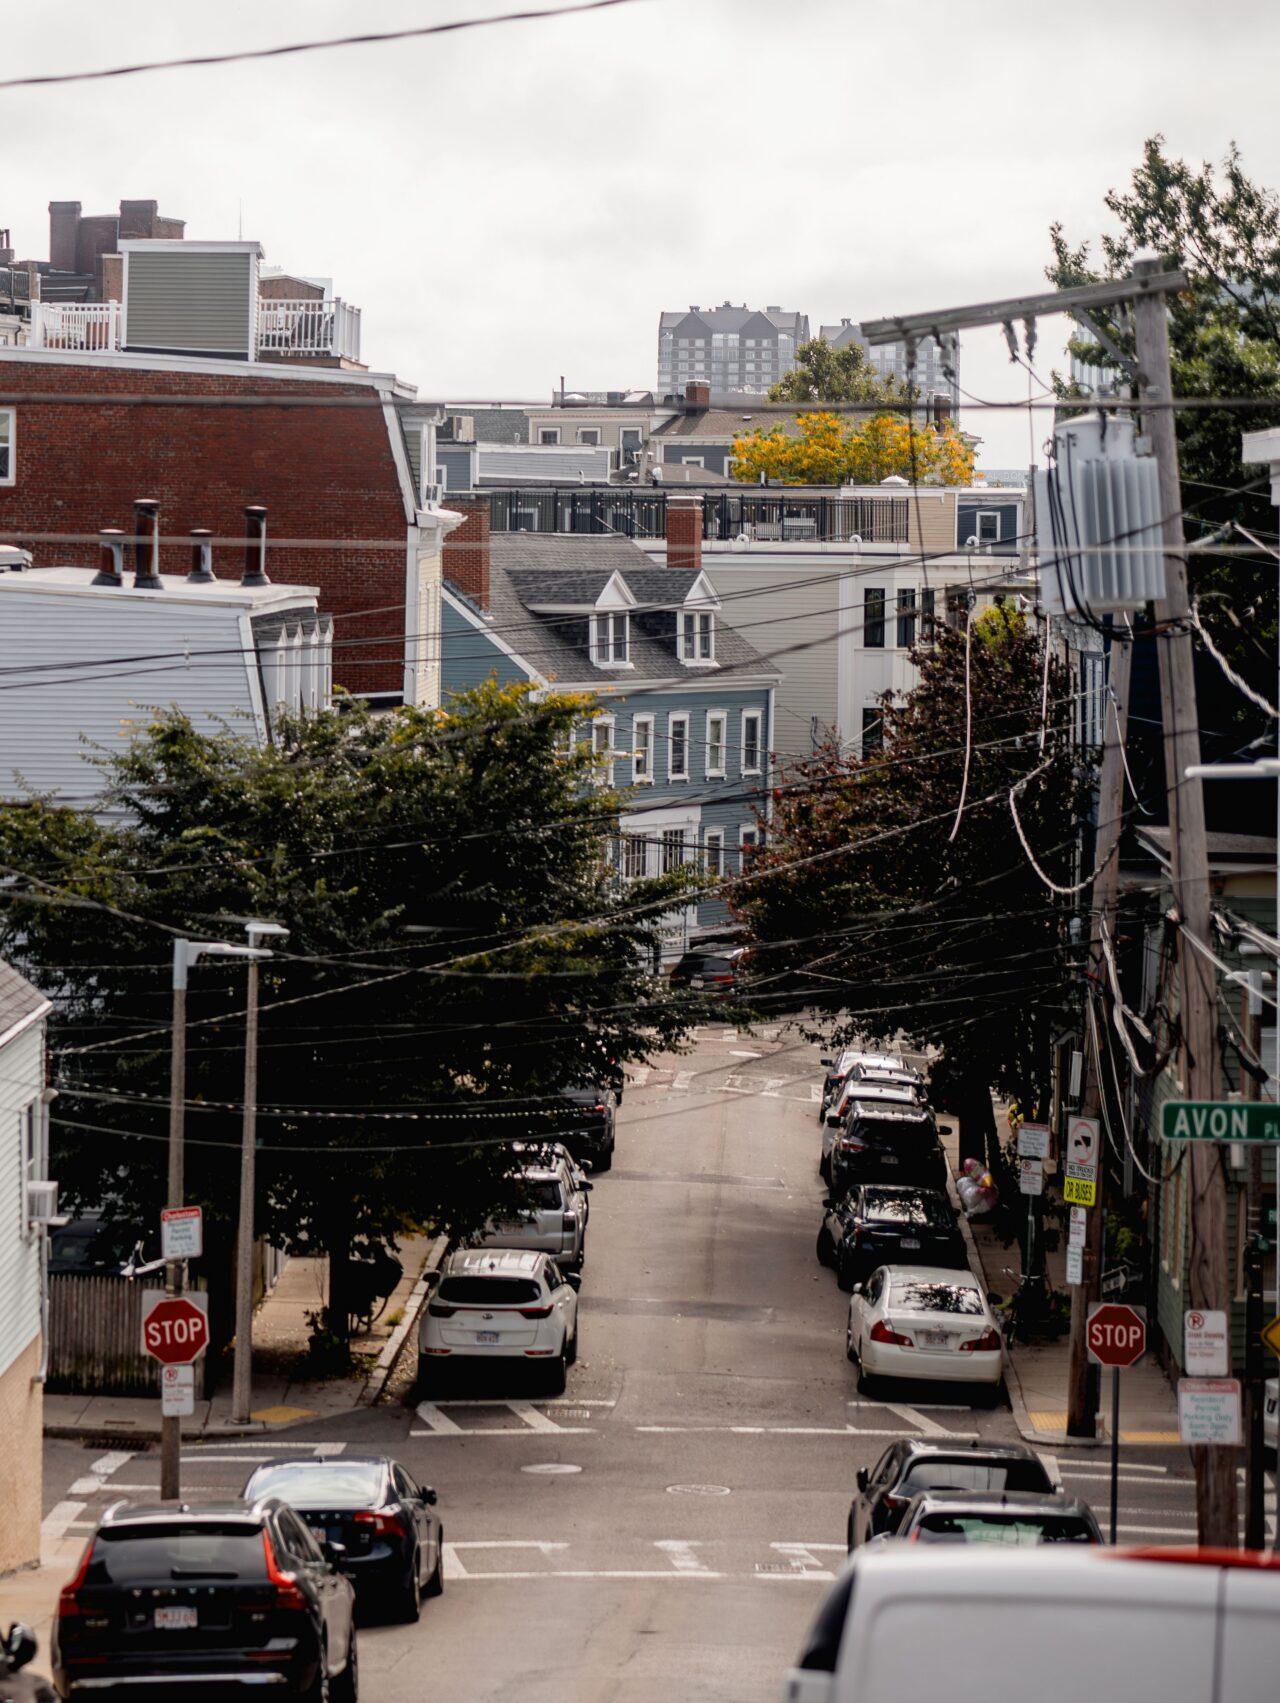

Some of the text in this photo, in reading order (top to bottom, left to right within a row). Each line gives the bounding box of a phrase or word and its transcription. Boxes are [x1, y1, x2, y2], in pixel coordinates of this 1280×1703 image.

[1173, 1107, 1248, 1137] AVON
[1066, 1181, 1092, 1202] OR BUSES
[148, 1317, 202, 1347] STOP
[1091, 1323, 1141, 1348] STOP
